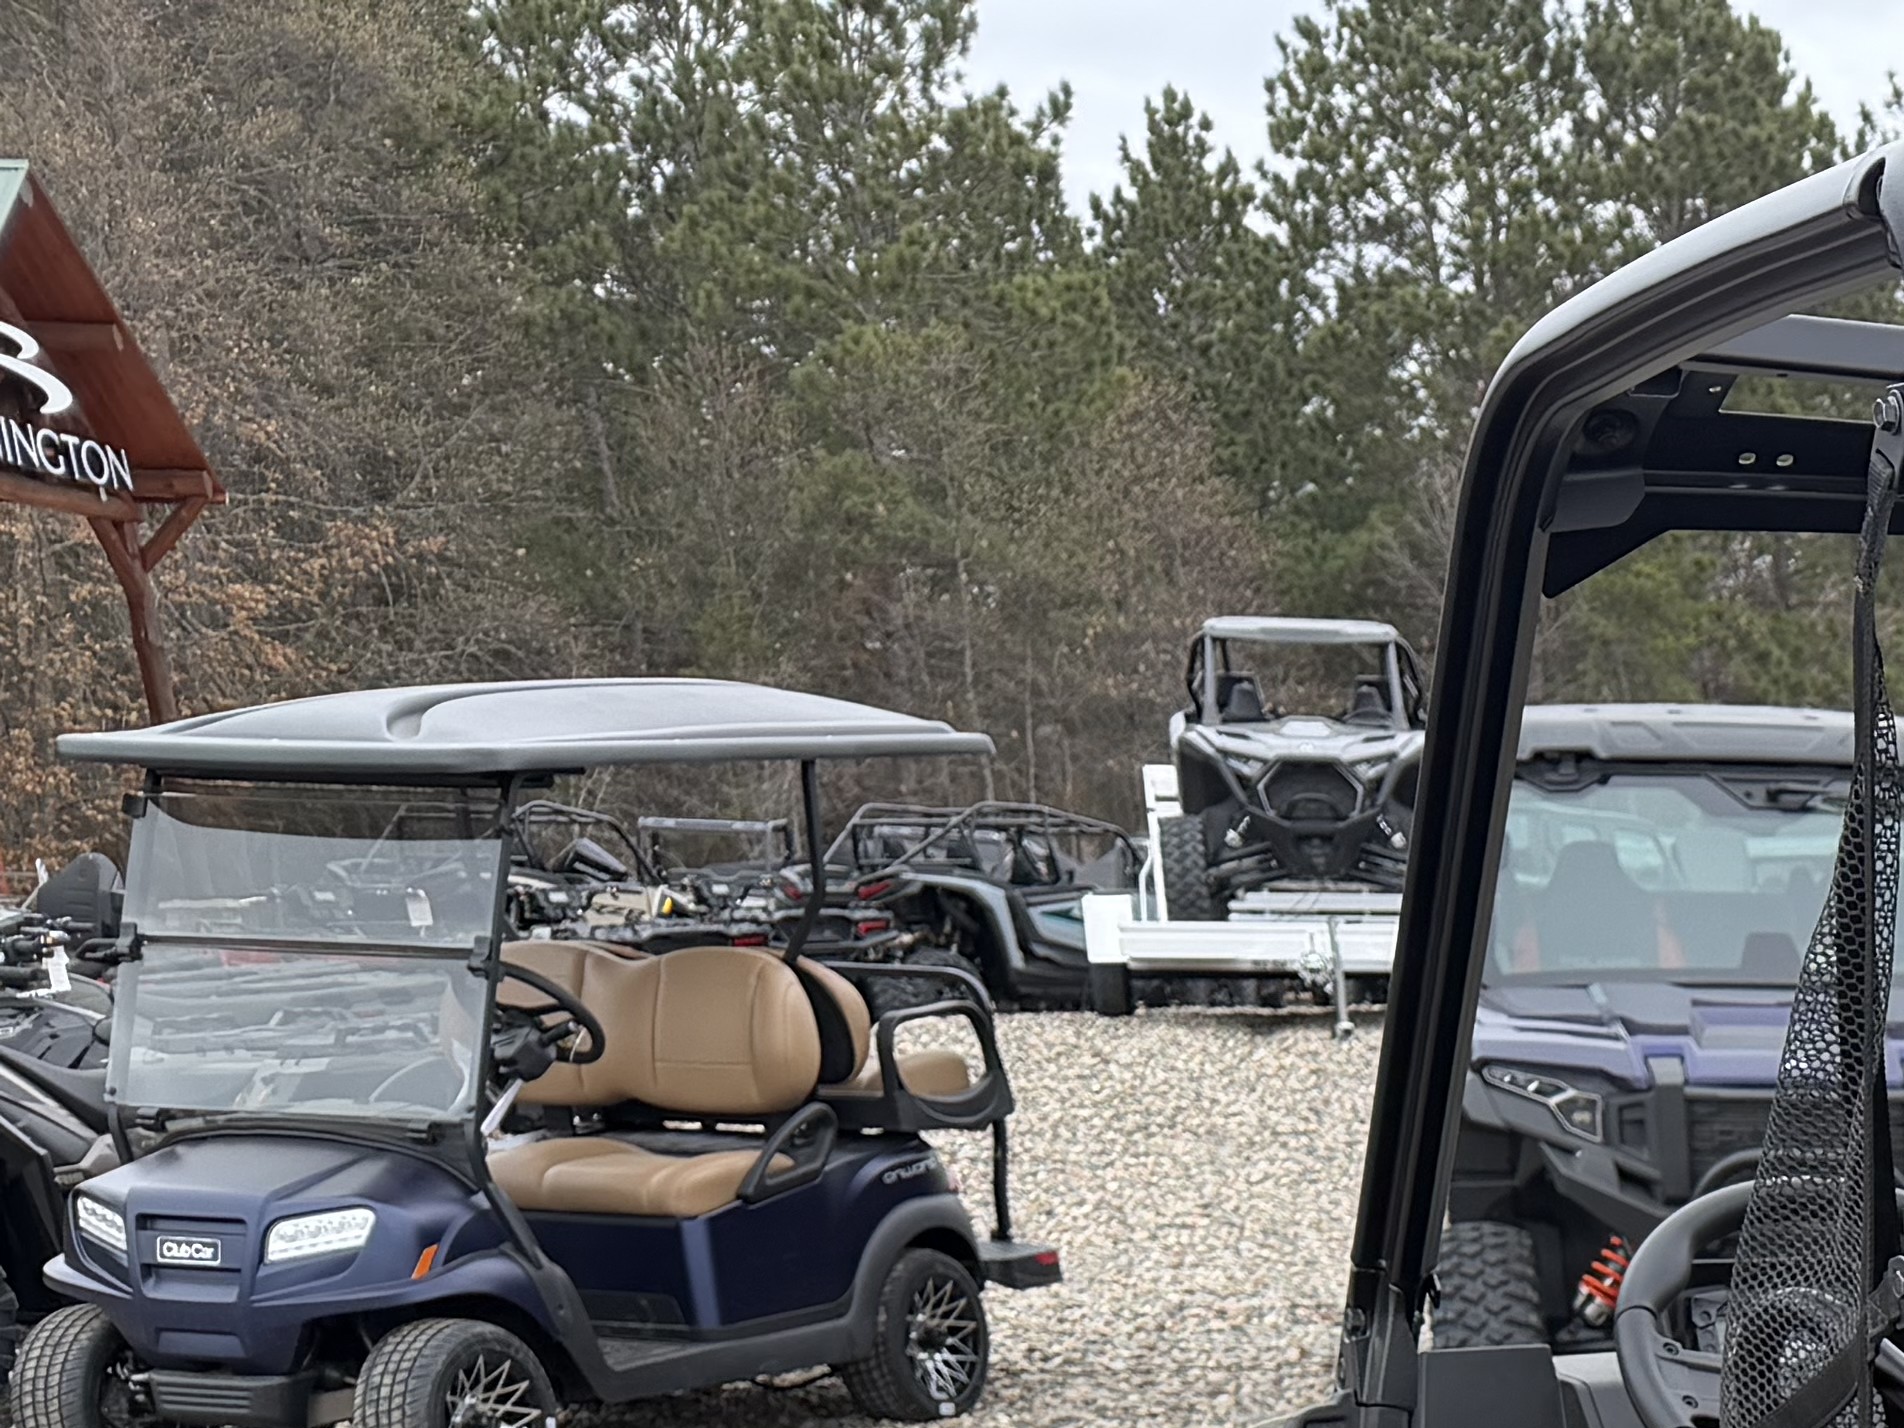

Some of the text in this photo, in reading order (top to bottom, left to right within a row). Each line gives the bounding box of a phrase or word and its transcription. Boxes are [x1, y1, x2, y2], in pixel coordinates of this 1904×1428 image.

[0, 415, 134, 492] INGTON
[163, 1241, 214, 1259] Club Car
